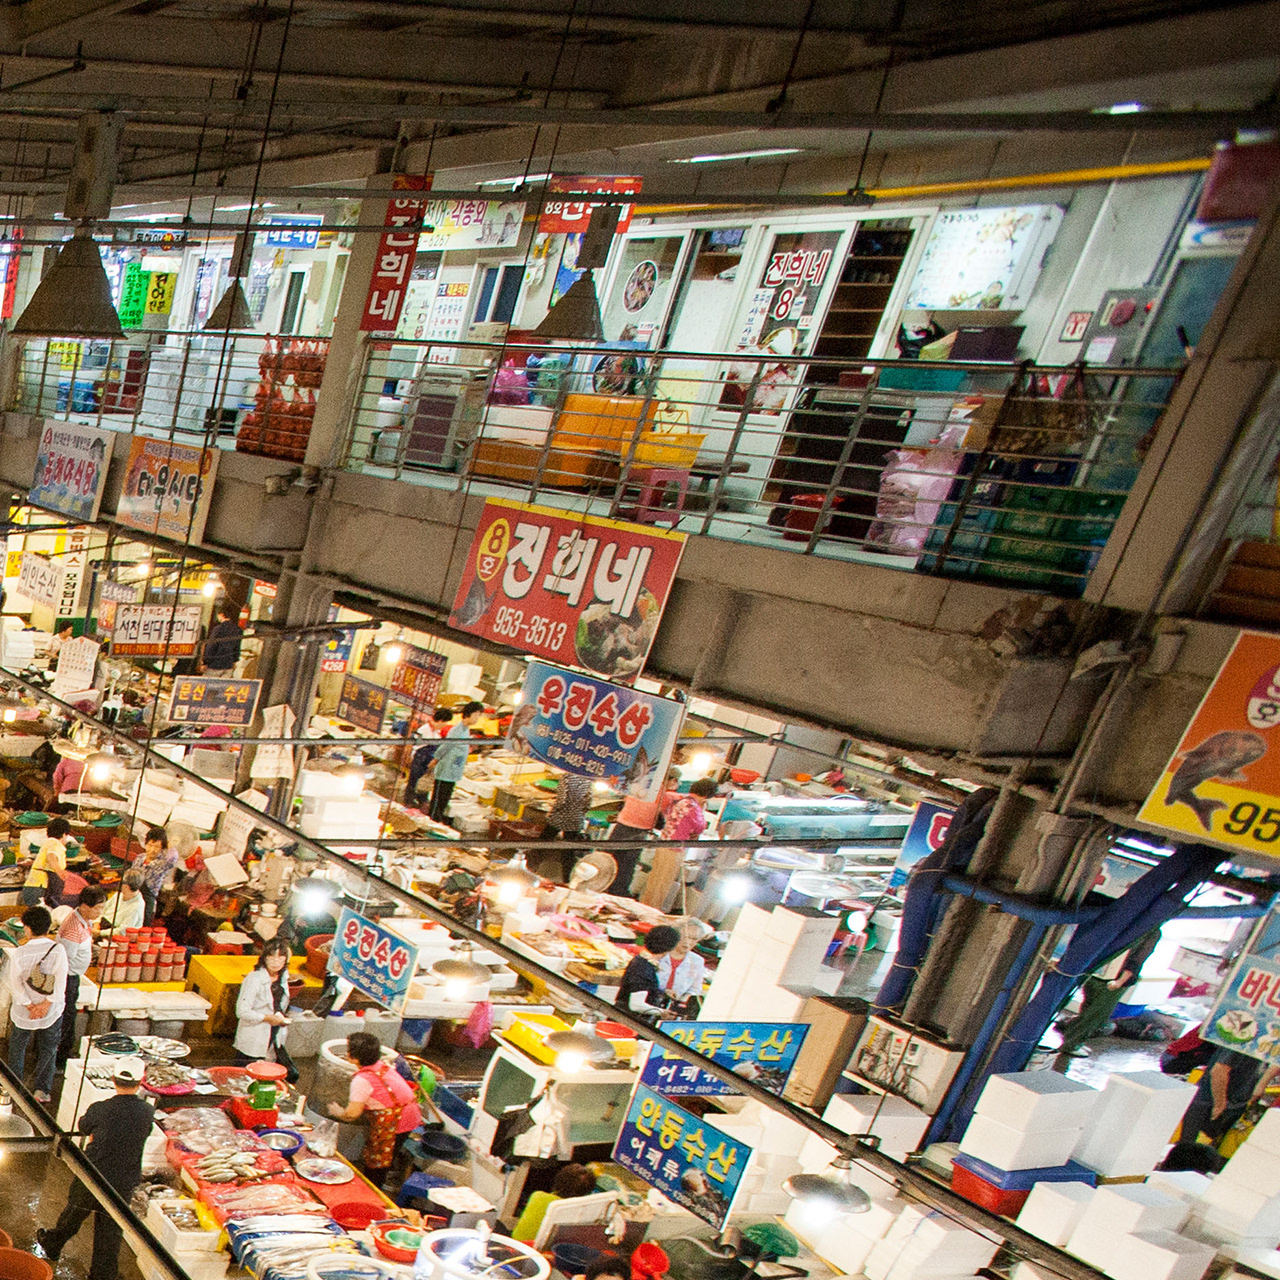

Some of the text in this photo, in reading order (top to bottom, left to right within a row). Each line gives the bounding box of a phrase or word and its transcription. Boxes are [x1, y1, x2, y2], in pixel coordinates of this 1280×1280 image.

[764, 249, 833, 287] 진희네
[502, 522, 652, 620] 진희네
[493, 605, 568, 652] 953-3513
[630, 1137, 680, 1181] 어패류
[636, 1096, 738, 1183] 안동수산
